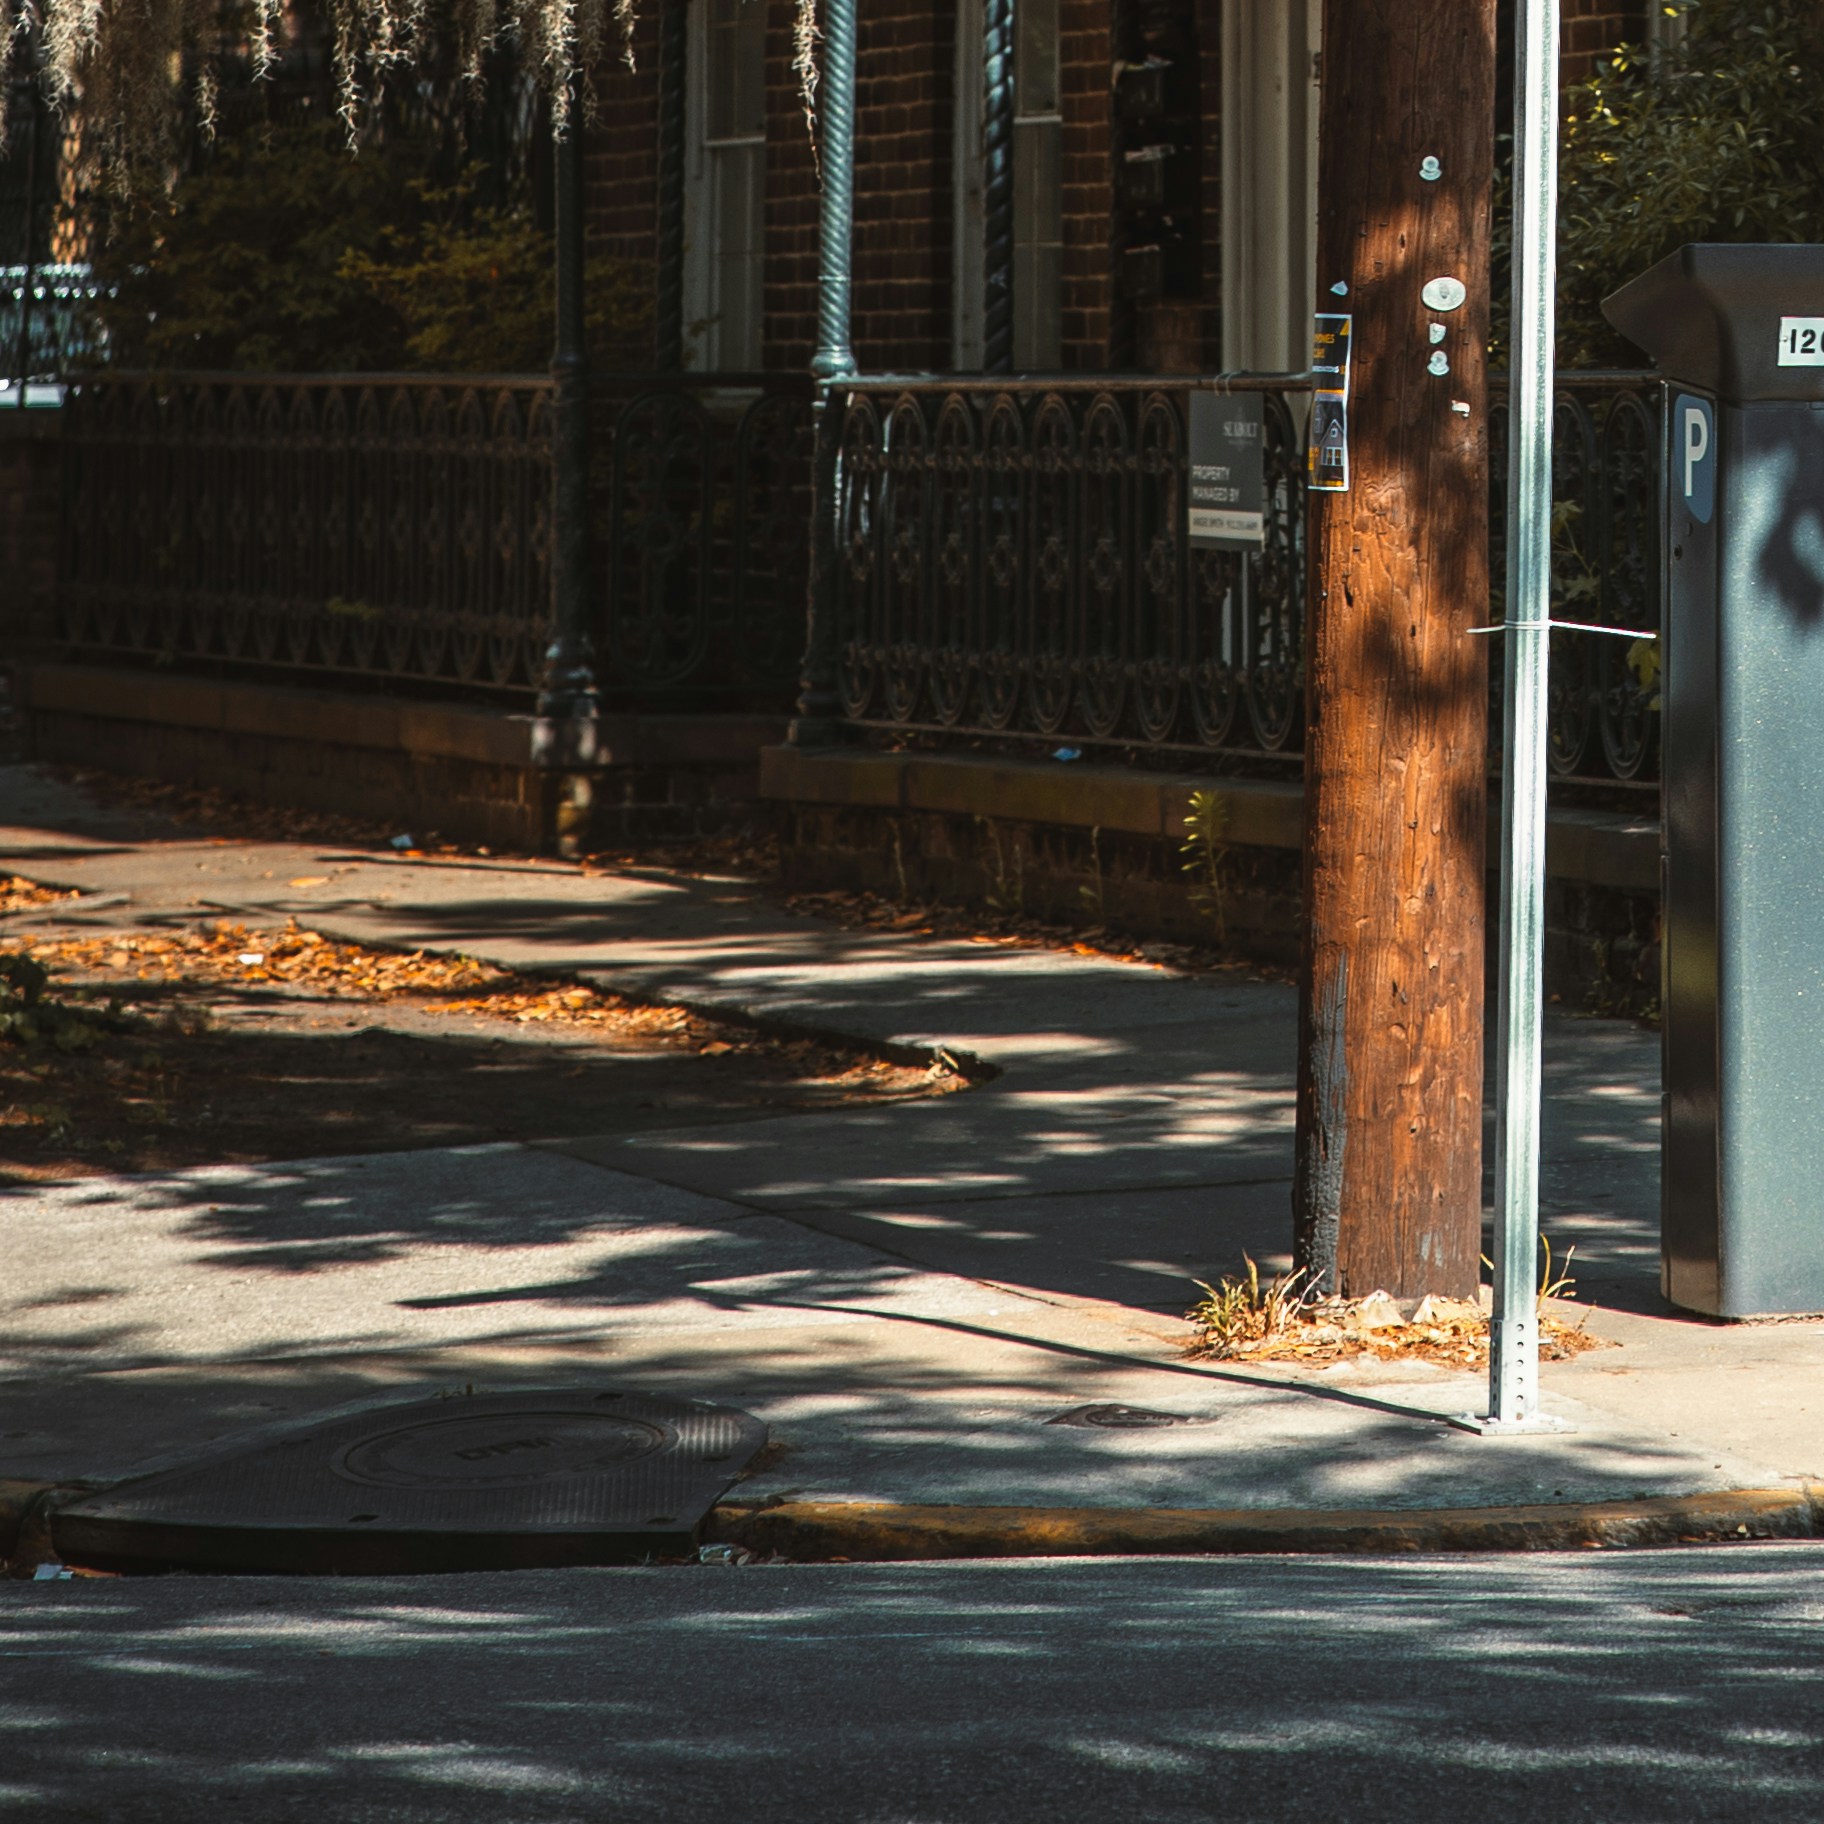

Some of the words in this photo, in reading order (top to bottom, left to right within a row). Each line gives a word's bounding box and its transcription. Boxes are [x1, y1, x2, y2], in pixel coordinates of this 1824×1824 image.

[1684, 407, 1709, 497] P
[1192, 464, 1230, 481] PROPERTY
[1192, 485, 1227, 502] MANAGED
[1229, 487, 1240, 503] BY
